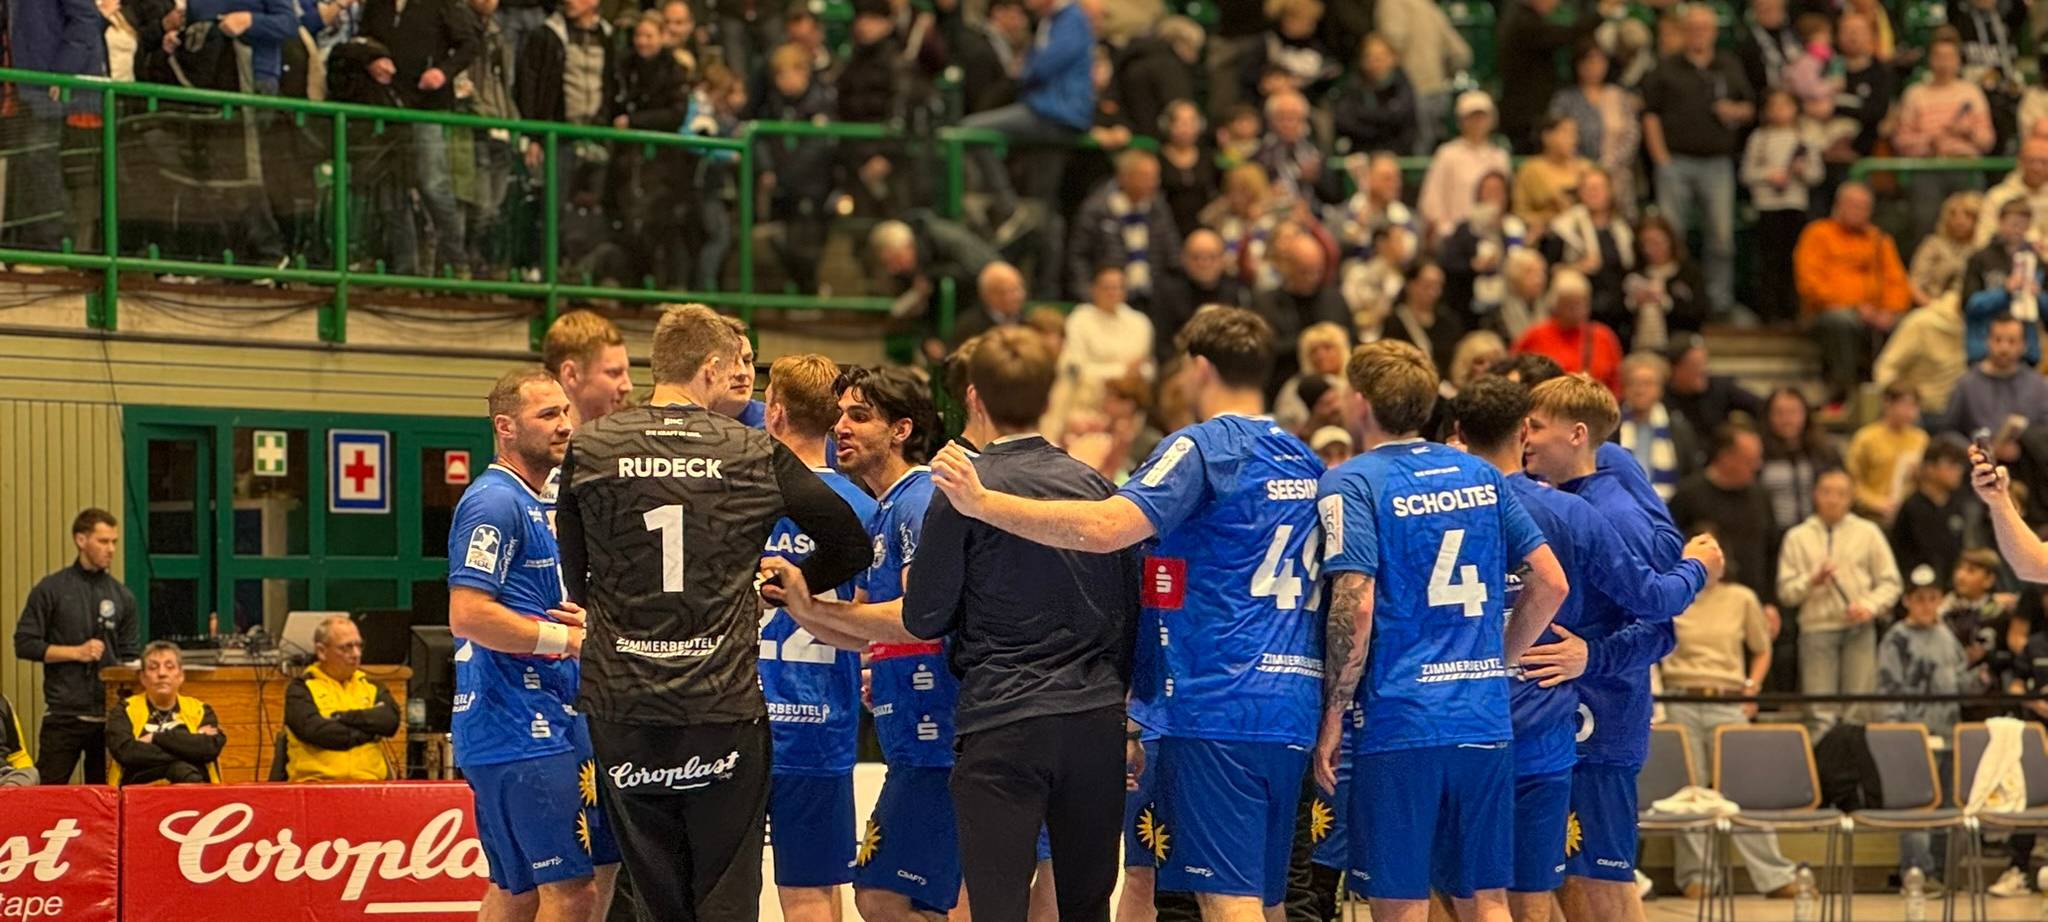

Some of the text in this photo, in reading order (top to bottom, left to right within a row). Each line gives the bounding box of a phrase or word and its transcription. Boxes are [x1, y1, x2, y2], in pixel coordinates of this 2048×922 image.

[618, 457, 723, 479] RUDECK
[1393, 484, 1498, 517] SCHOLTES
[643, 504, 685, 593] 1
[1427, 528, 1489, 617] 4
[608, 751, 740, 789] Coroplast
[158, 803, 490, 900] Coropla
